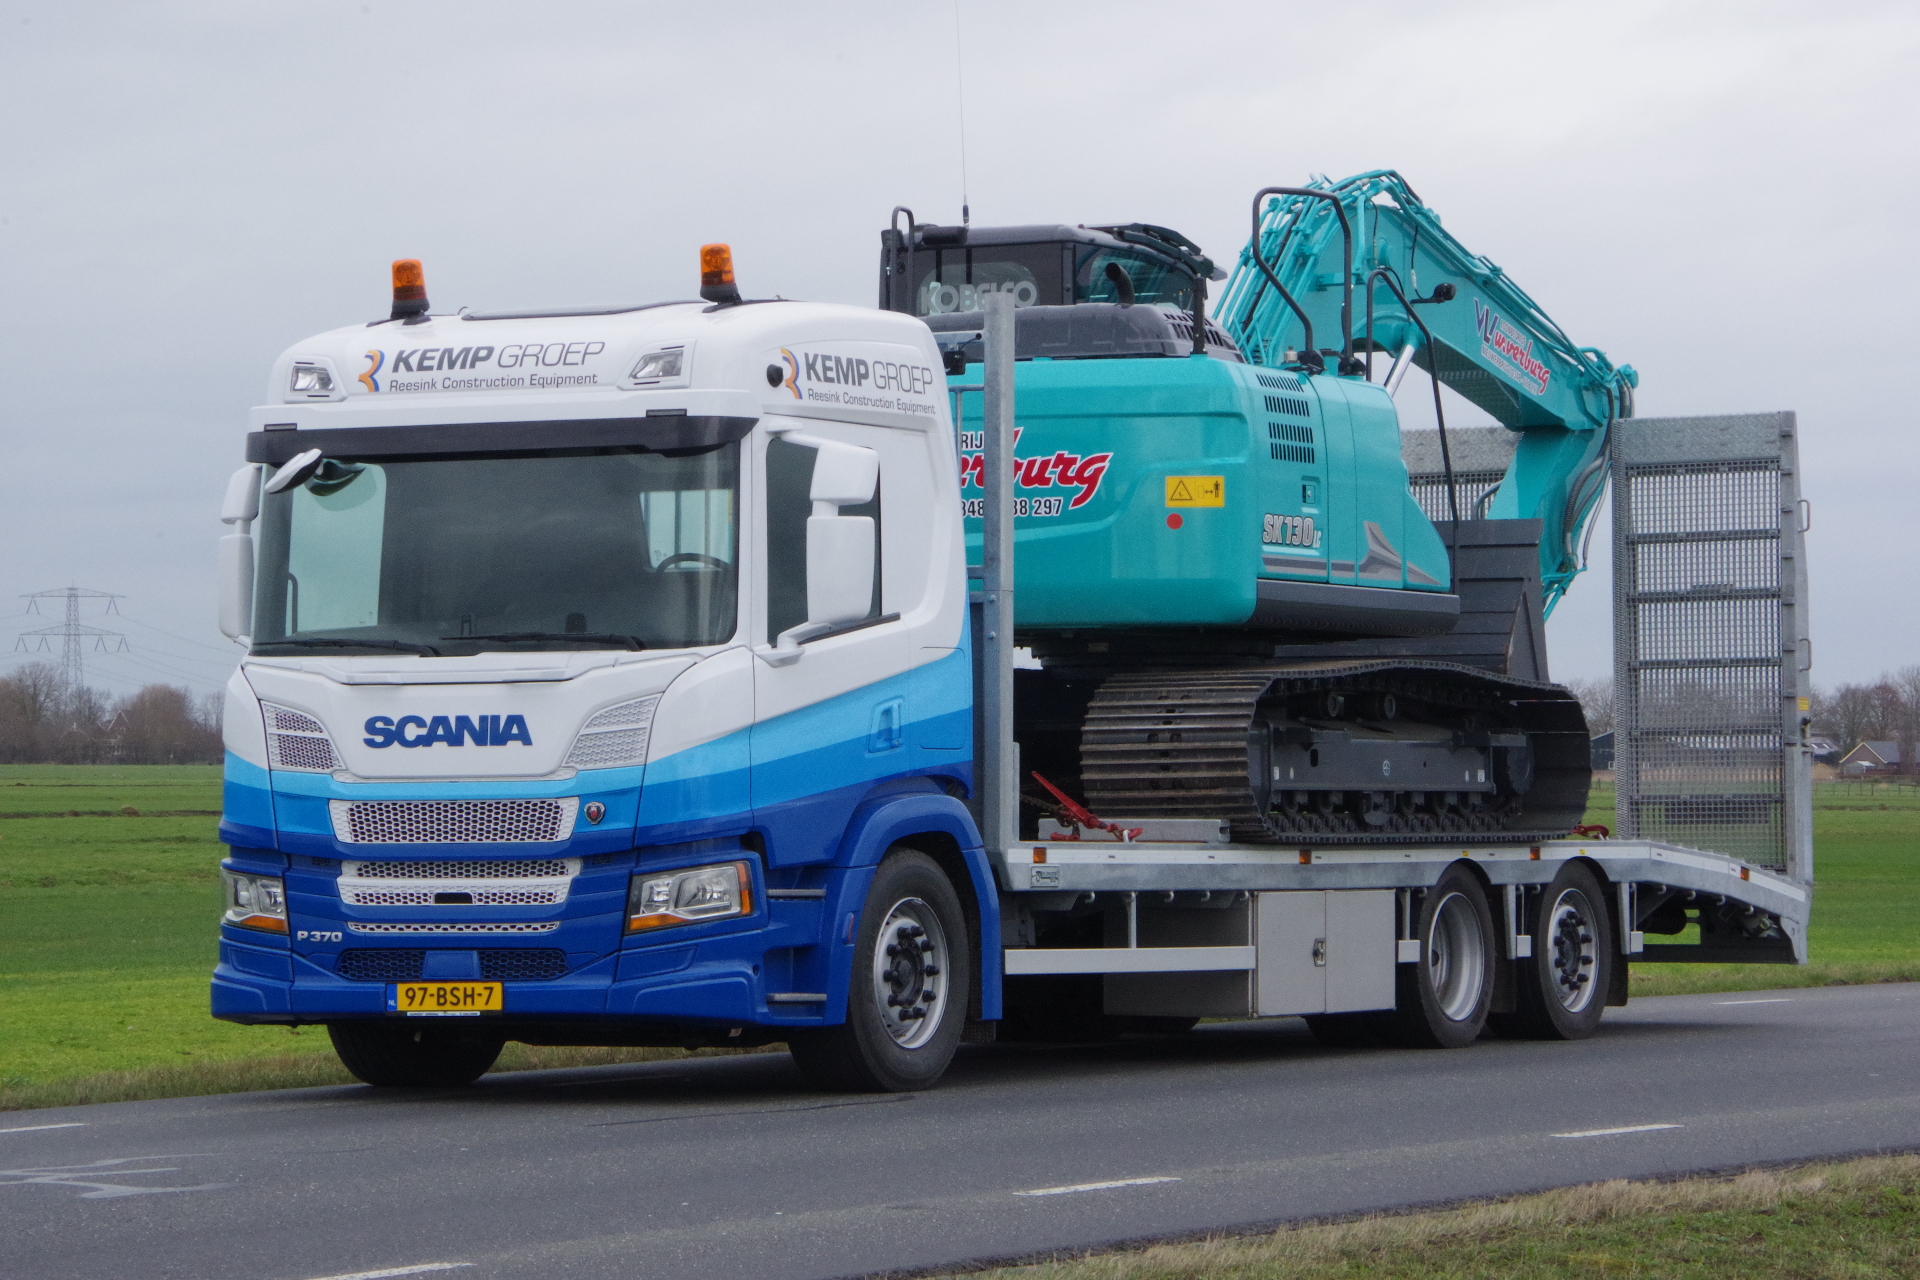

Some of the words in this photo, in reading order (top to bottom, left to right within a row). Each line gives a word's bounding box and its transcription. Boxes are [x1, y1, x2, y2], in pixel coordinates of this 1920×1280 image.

[392, 346, 495, 373] KEMP
[497, 341, 605, 368] GROEP
[389, 379, 437, 392] Reesink
[442, 375, 524, 389] Construction
[529, 373, 598, 389] Equipment
[804, 352, 870, 387] KEMP
[872, 360, 933, 395] GROEP
[808, 388, 840, 404] Reesink
[842, 392, 895, 410] Construction
[896, 398, 936, 416] Equipment
[1033, 499, 1063, 516] 297
[363, 714, 533, 748] SCANIA
[297, 930, 308, 942] P
[310, 931, 343, 943] 370
[404, 986, 495, 1007] 97-BSH-7
